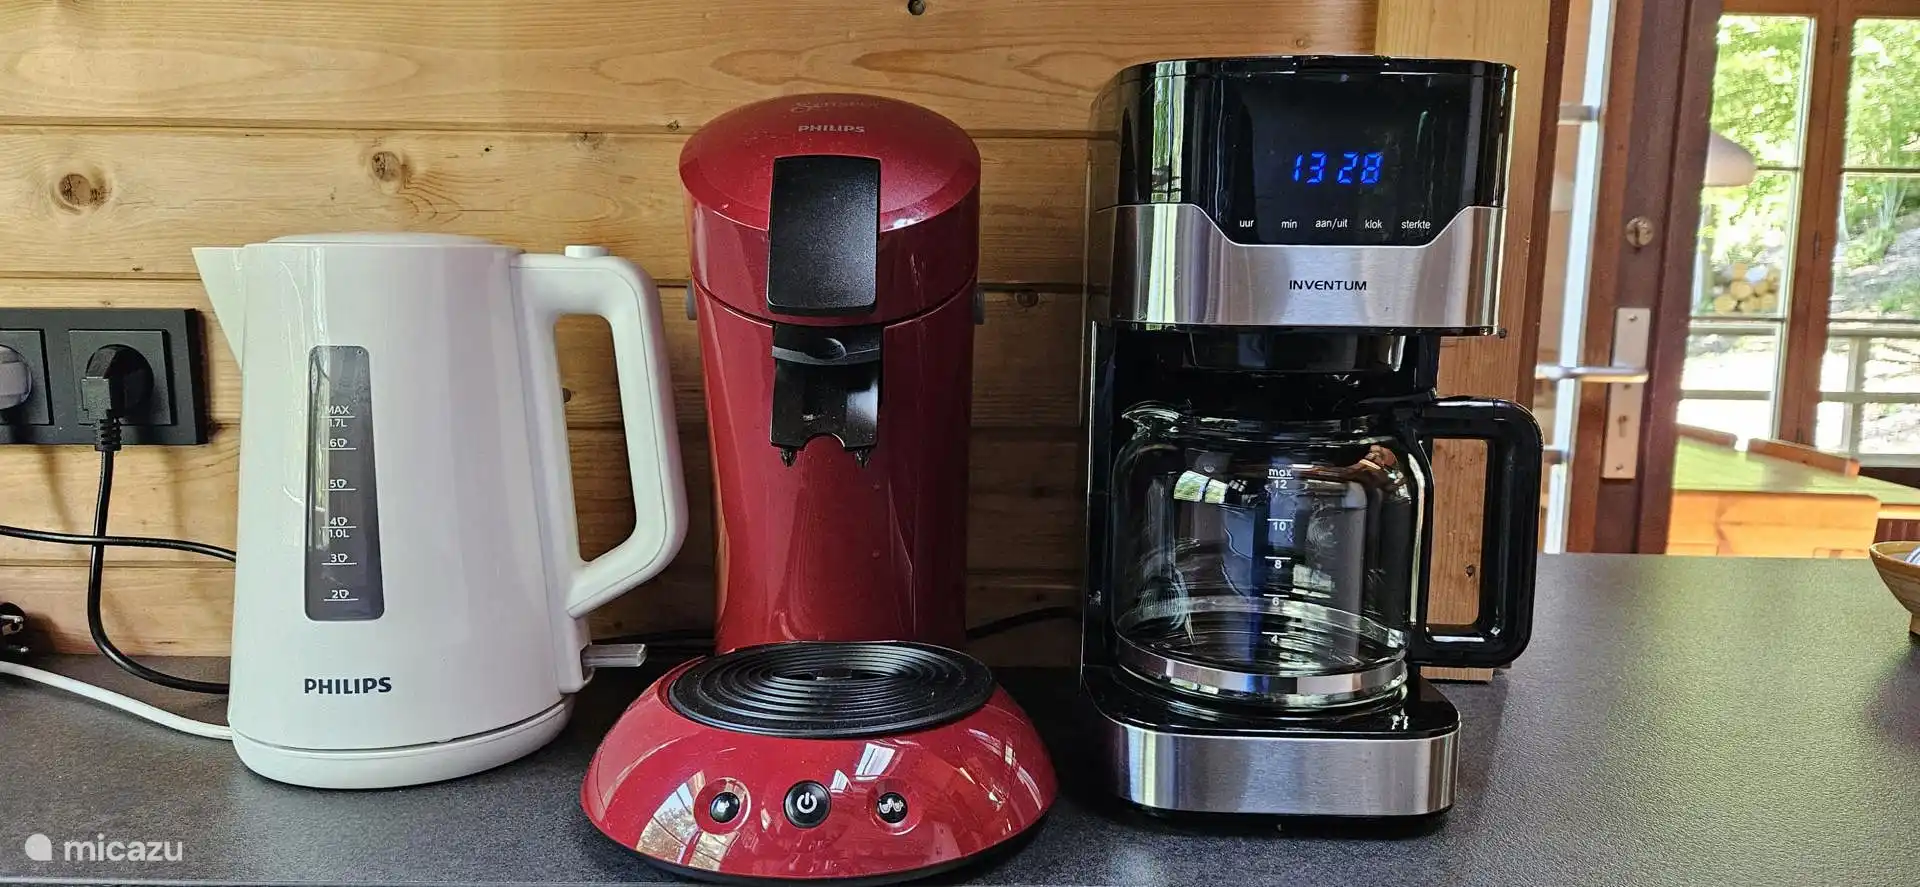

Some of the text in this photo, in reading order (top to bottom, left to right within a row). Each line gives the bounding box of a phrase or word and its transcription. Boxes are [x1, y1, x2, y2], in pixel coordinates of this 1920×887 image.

[798, 124, 865, 133] PHILIPS
[1239, 218, 1431, 230] uur min aan/uit klok sterkte
[1289, 280, 1367, 290] INVENTUM
[324, 405, 350, 415] MAX
[329, 418, 348, 428] 1.7L
[329, 438, 337, 448] 6
[1268, 468, 1292, 477] max
[329, 479, 336, 488] 5
[1273, 480, 1288, 489] 12
[329, 517, 337, 526] 4
[1272, 521, 1287, 531] 10
[328, 528, 350, 538] 1.0L
[330, 553, 337, 563] 3
[1274, 559, 1282, 569] 8
[331, 589, 339, 599] 2
[1271, 596, 1280, 606] 6
[1270, 634, 1279, 644] 4
[304, 676, 392, 694] PHILIPS
